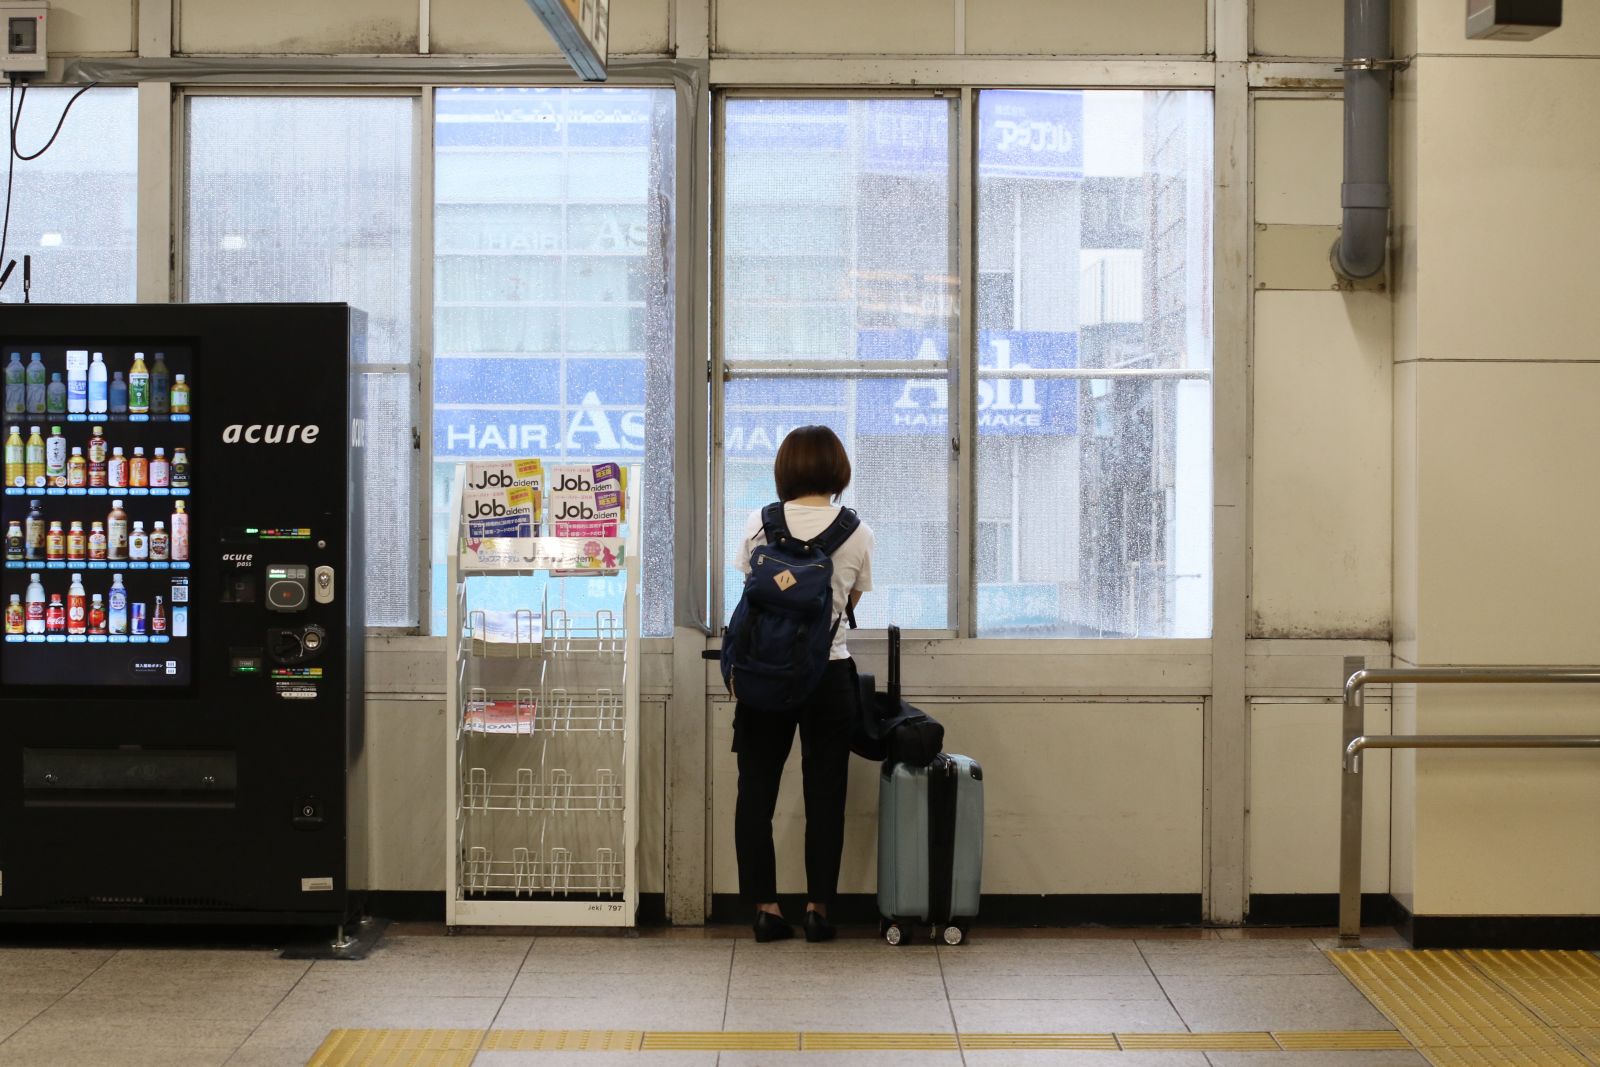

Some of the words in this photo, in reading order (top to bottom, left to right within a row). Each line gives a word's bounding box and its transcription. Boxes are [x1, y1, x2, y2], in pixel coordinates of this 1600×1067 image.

[894, 337, 1042, 410] Ah
[222, 424, 320, 444] acure
[447, 424, 548, 450] HAIR
[475, 469, 514, 490] Job
[513, 479, 539, 487] aidem
[553, 474, 591, 492] Job
[467, 498, 506, 519] Job
[506, 506, 531, 516] aidem
[554, 501, 594, 520] Job
[593, 511, 618, 520] aidem
[222, 553, 253, 561] acure
[607, 904, 623, 912] 797
